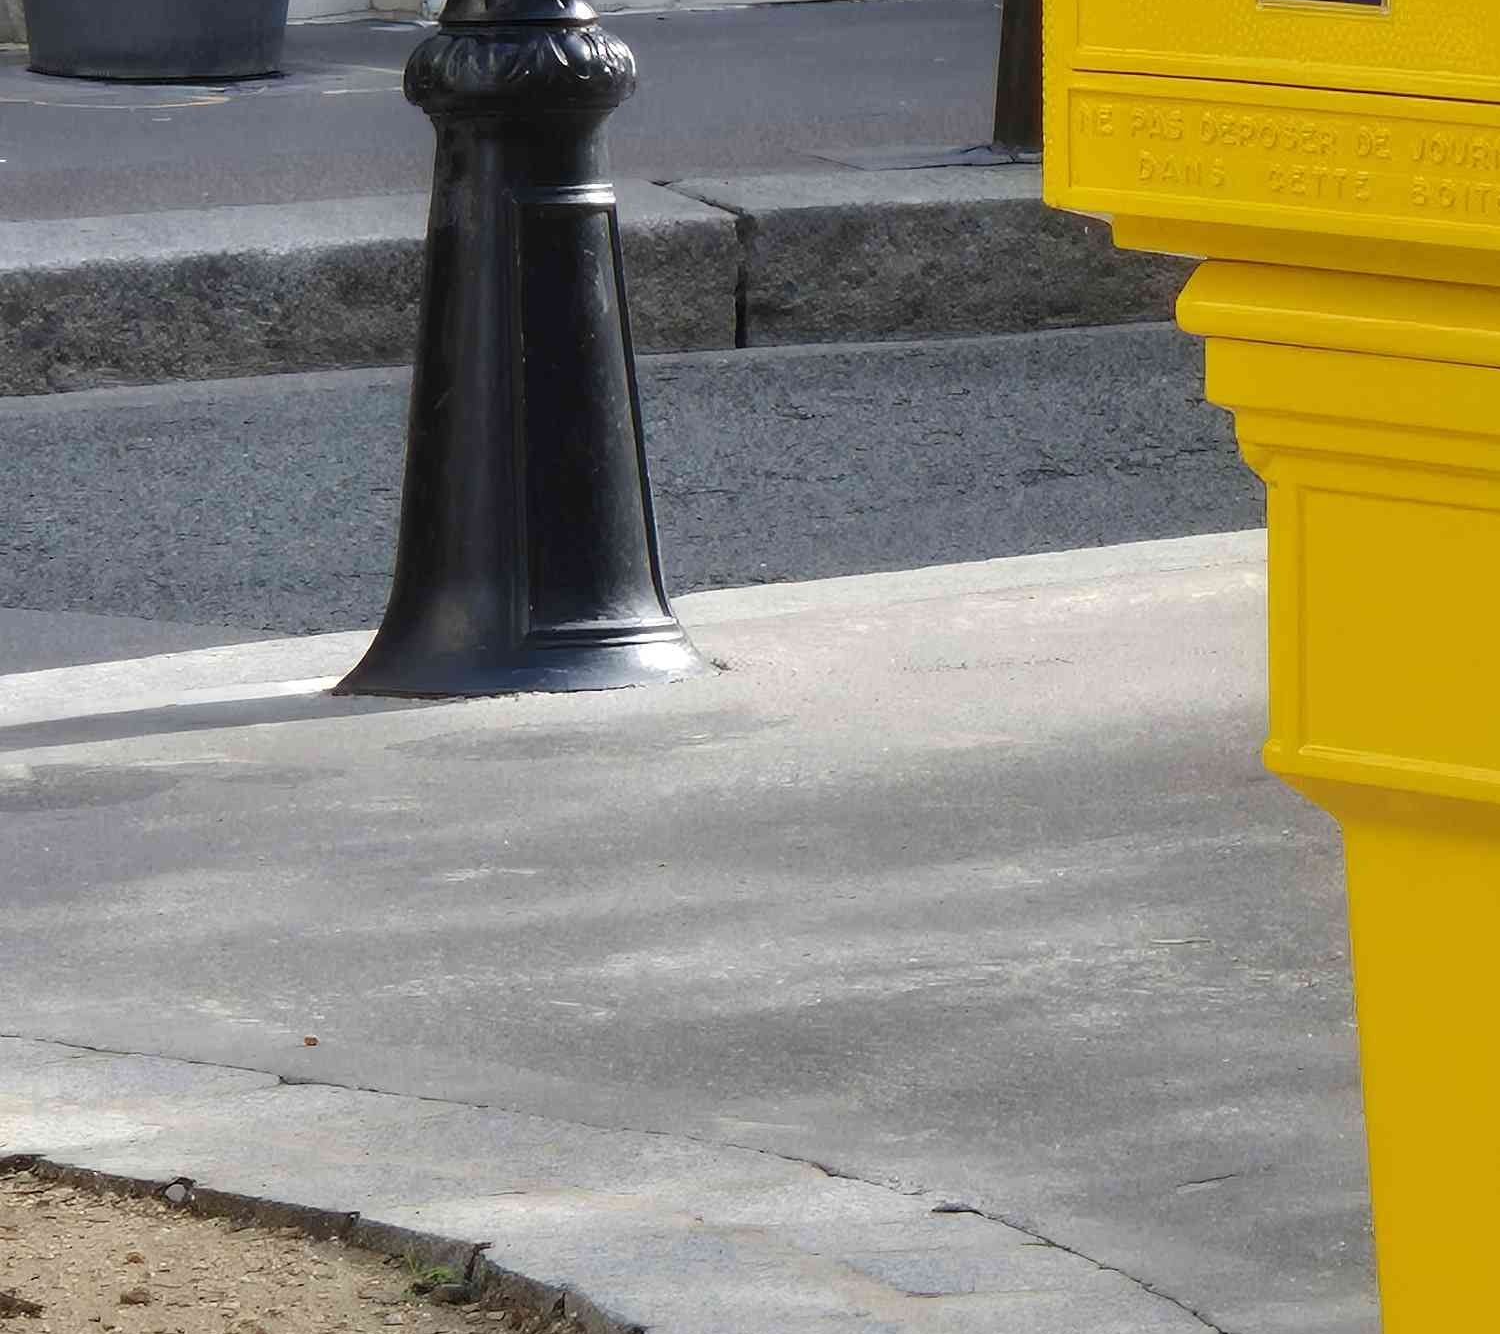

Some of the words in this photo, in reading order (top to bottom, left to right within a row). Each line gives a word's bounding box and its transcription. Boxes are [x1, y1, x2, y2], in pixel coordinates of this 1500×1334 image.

[1130, 107, 1184, 141] PAS
[1200, 109, 1337, 156] DEPOSER
[1356, 124, 1392, 161] DE
[1139, 149, 1225, 189] DANS
[1268, 163, 1371, 203] CETTE
